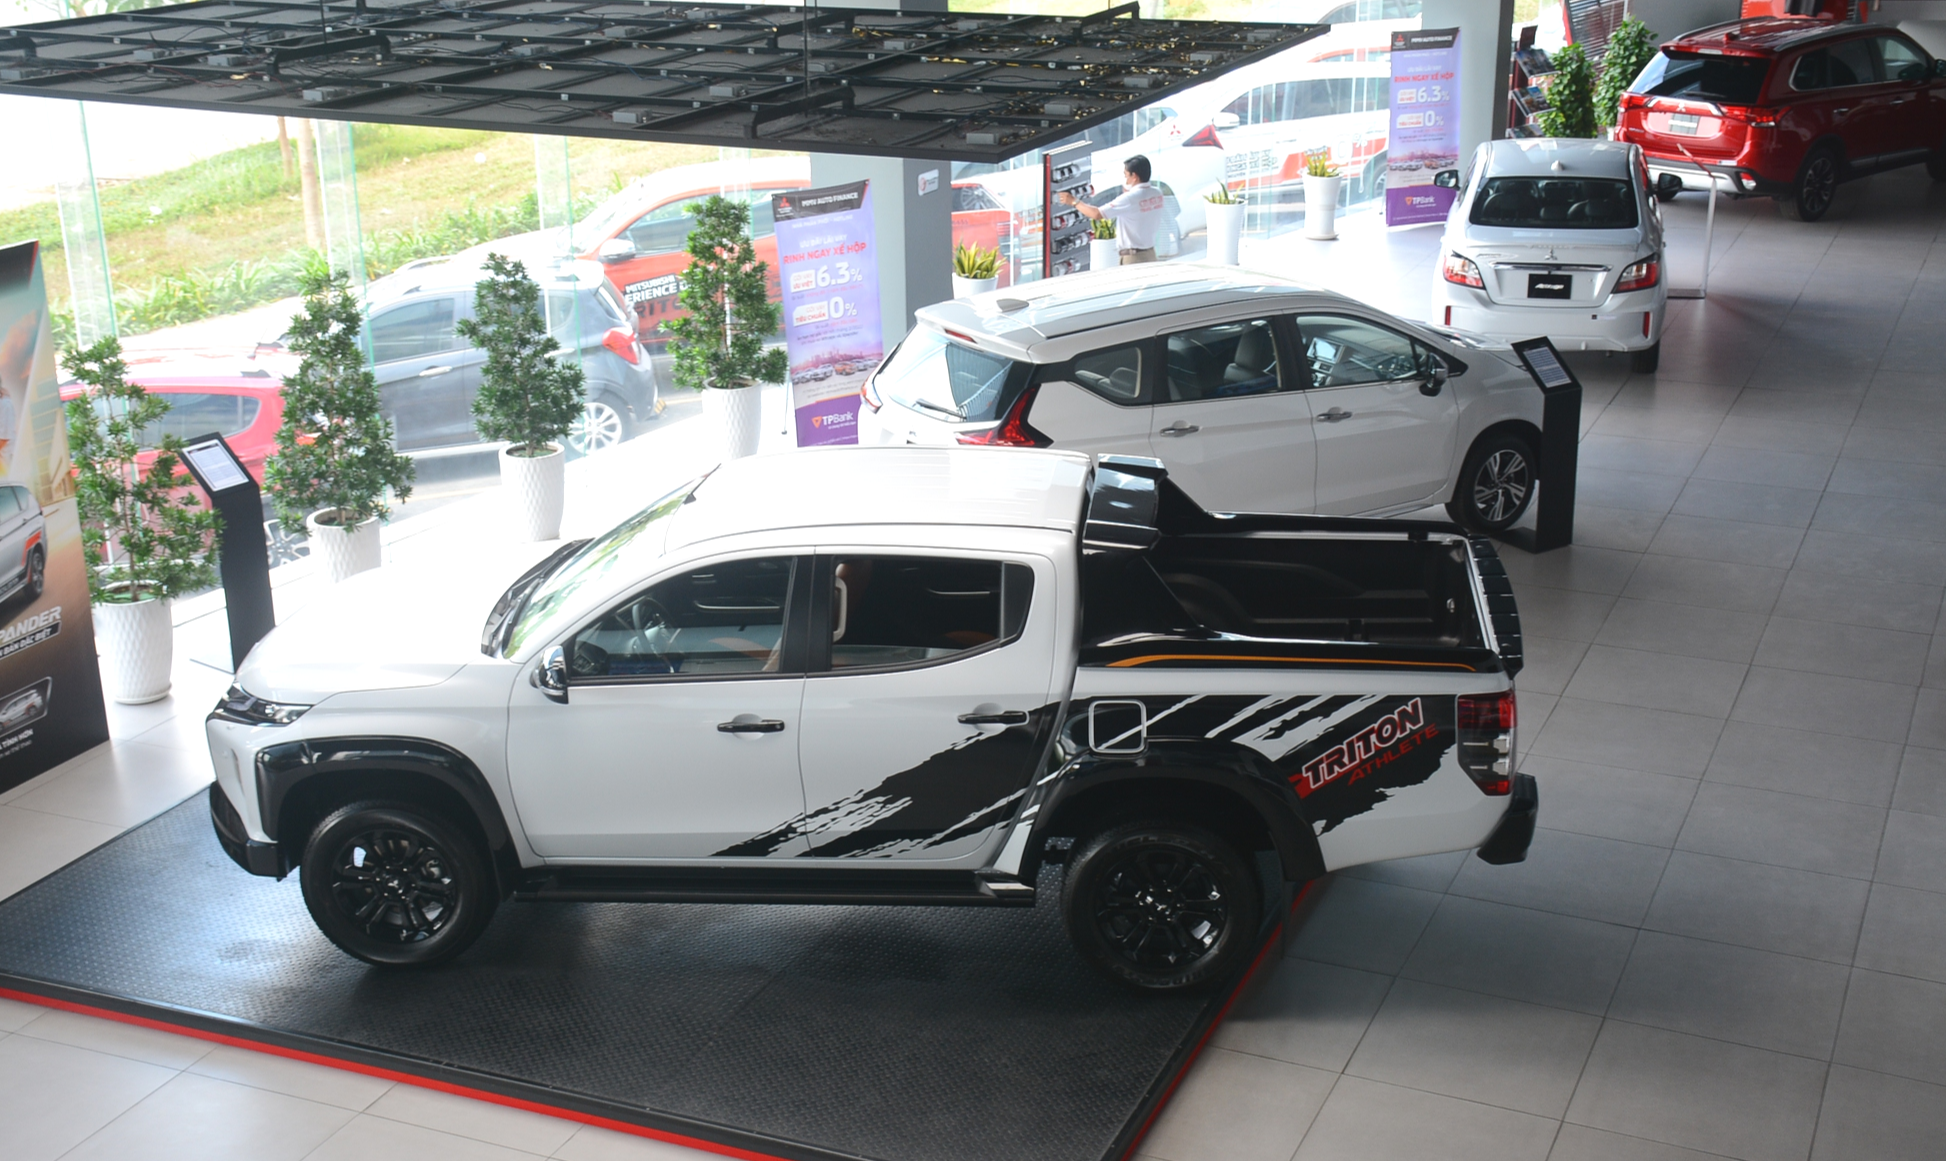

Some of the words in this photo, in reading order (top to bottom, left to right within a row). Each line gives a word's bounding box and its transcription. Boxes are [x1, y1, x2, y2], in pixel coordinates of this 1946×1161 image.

[818, 196, 832, 205] AUTO
[834, 192, 858, 202] FINANCE
[784, 253, 806, 264] RINH
[808, 249, 832, 259] NGAY
[834, 243, 844, 255] XẾ
[846, 241, 866, 253] HỘP
[624, 274, 676, 294] MITSUBISHI
[816, 261, 864, 288] 6.3%
[829, 295, 858, 319] 0%
[822, 410, 855, 426] TPBank
[1302, 697, 1424, 789] TRITON
[1348, 723, 1440, 786] ATHLETE
